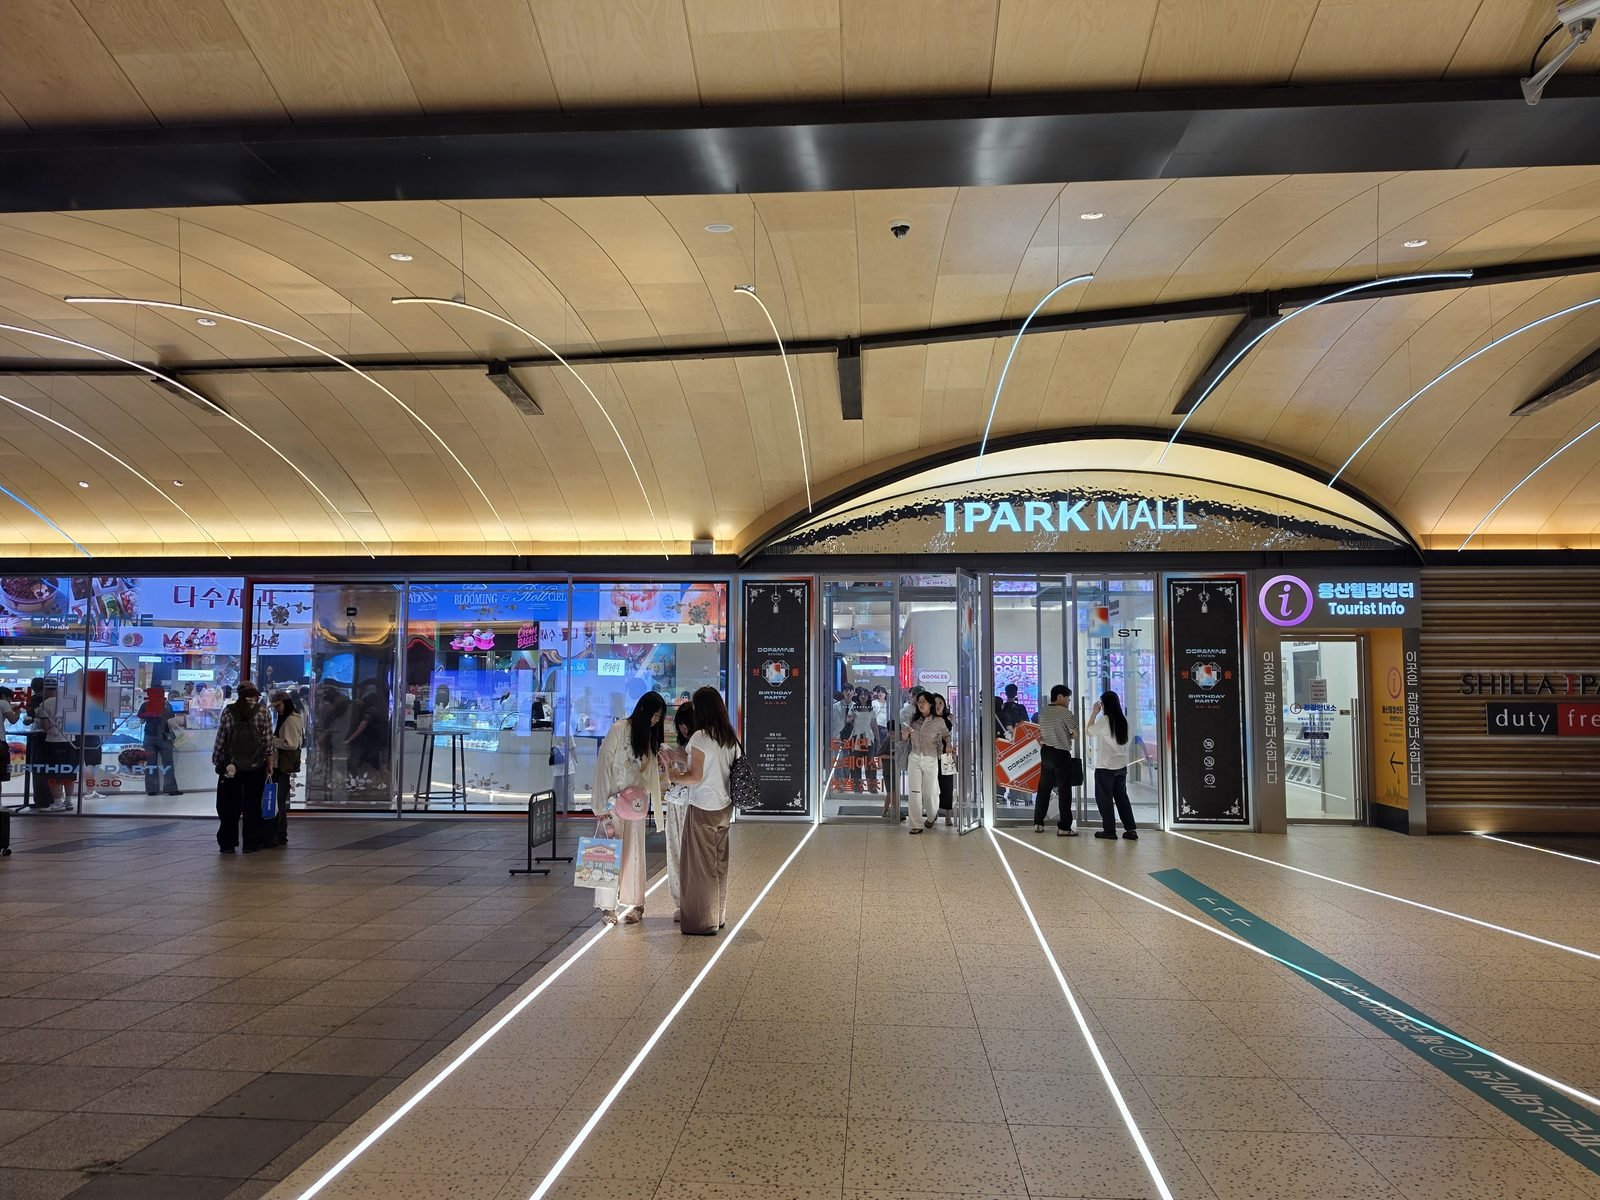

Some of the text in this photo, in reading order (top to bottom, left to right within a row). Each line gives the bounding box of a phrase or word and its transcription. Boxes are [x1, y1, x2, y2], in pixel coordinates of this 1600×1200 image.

[944, 499, 1198, 533] I PARK MALL
[1318, 582, 1415, 599] 용산웰컴센터
[1328, 601, 1405, 615] Tourist Info
[921, 672, 948, 680] GOOSLES
[1086, 670, 1148, 679] PARTY
[1460, 673, 1555, 695] SHILLA
[1263, 651, 1279, 785] 이곳은 관광안내소입니다
[1406, 651, 1422, 786] 이곳은 관광안내소입니다
[1495, 708, 1550, 732] duty
